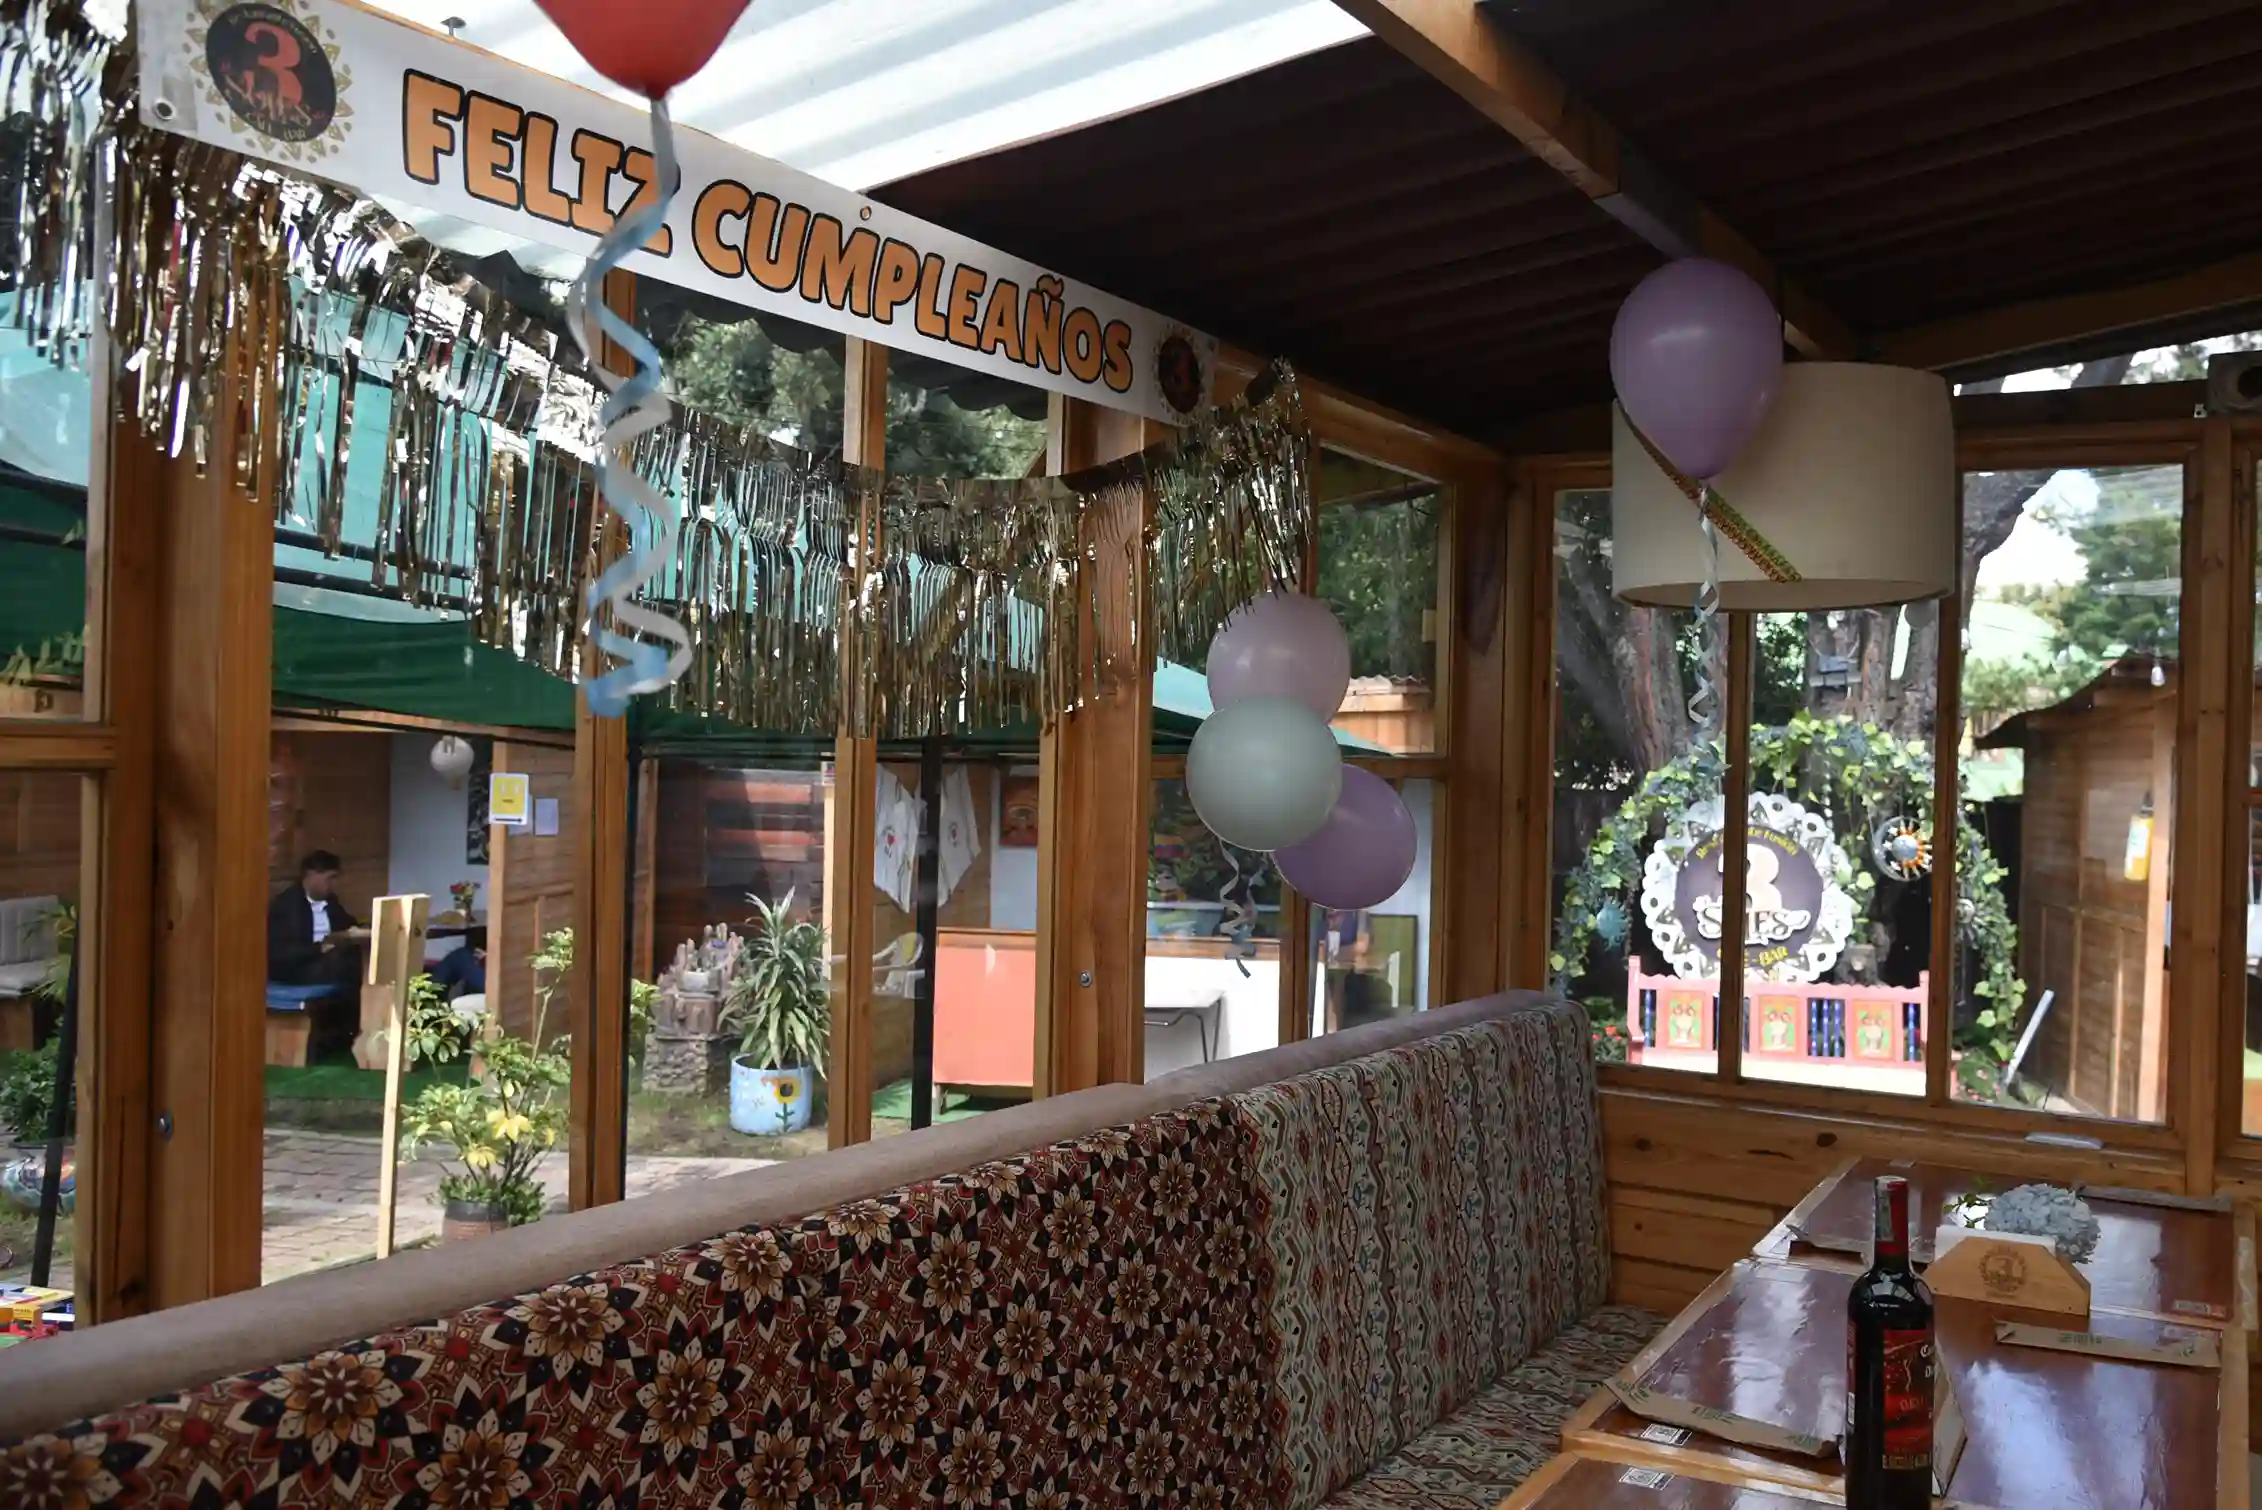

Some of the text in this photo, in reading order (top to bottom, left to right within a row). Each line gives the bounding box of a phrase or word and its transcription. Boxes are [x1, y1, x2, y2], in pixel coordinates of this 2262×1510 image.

[244, 21, 301, 106] 3
[402, 68, 1133, 394] FELIZ CUMPLEAÑOS
